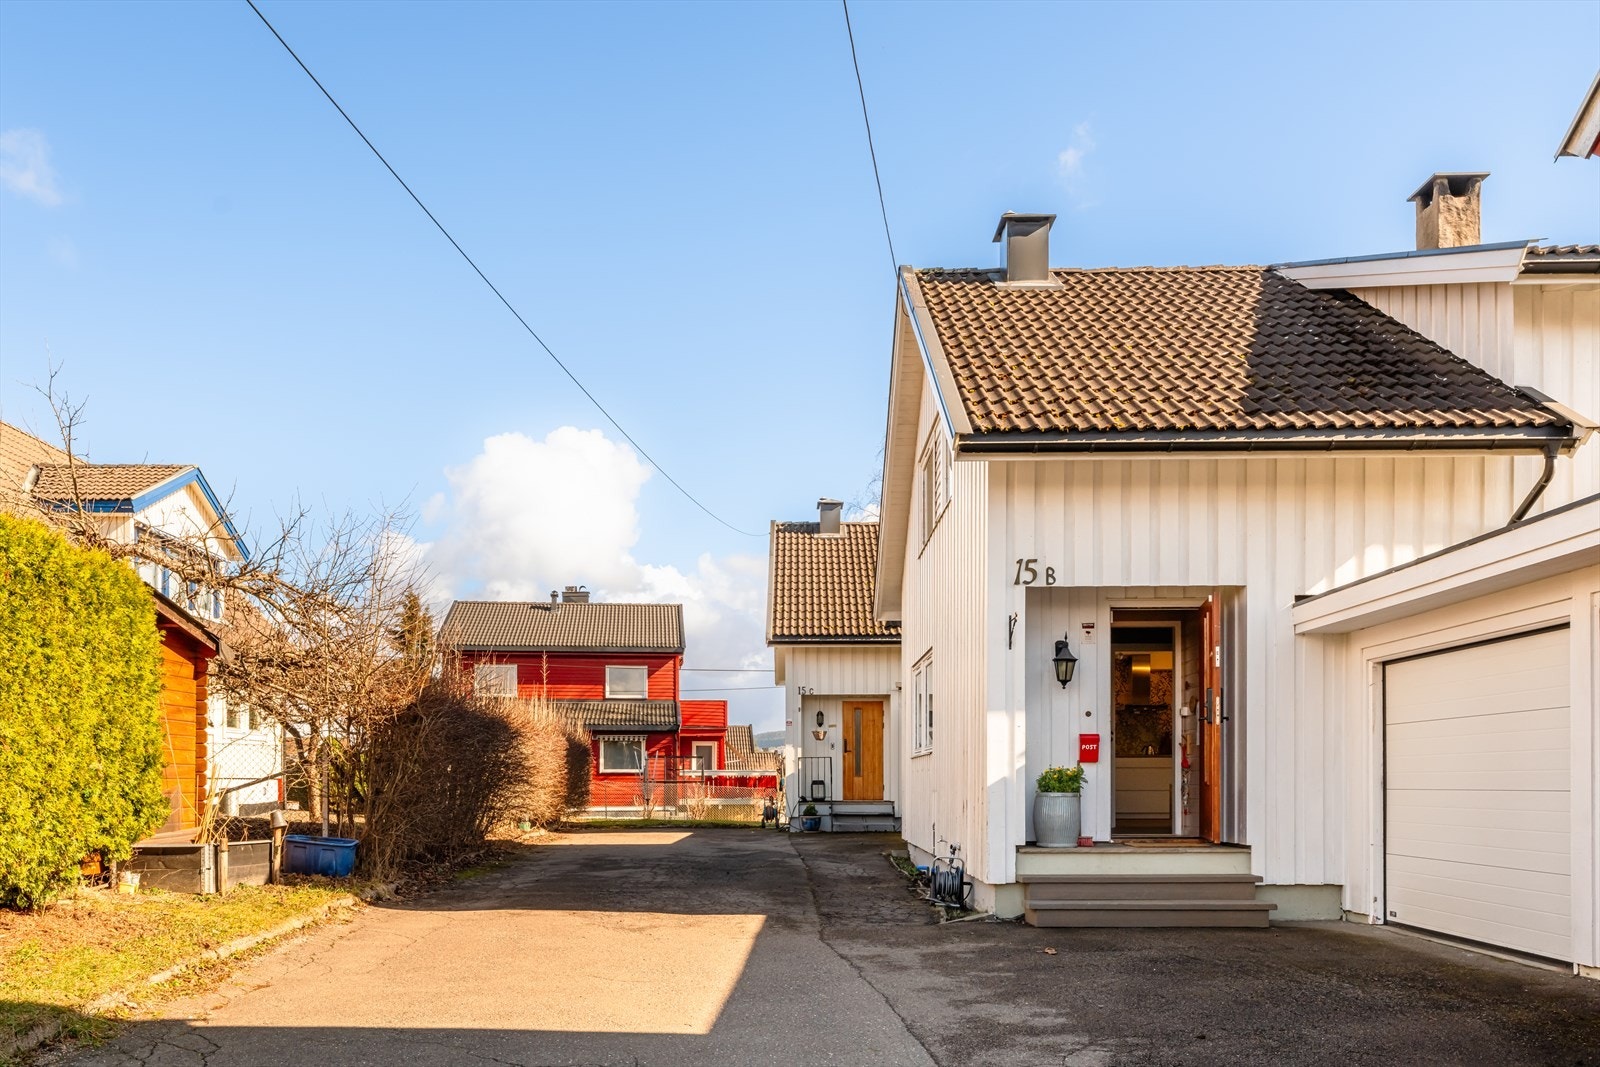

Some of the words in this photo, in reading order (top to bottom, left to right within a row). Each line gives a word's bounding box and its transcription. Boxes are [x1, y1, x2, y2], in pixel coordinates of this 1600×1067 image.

[1013, 558, 1038, 585] 15
[1045, 566, 1056, 586] B
[797, 686, 807, 696] 15
